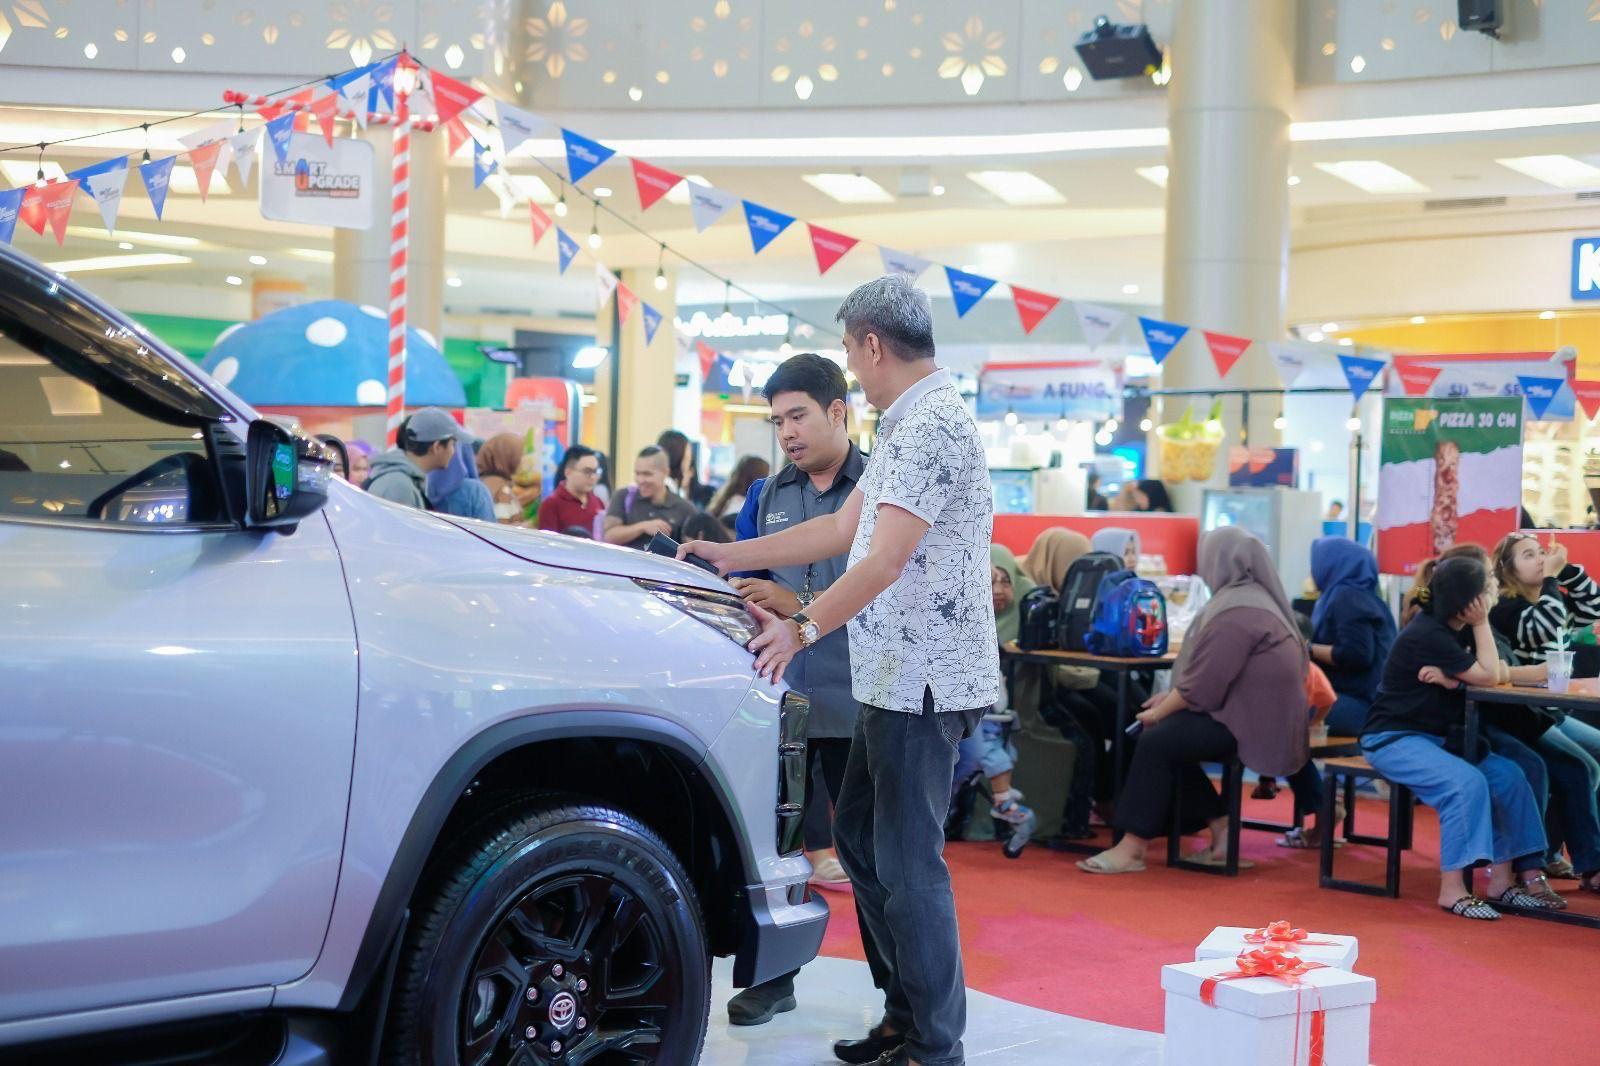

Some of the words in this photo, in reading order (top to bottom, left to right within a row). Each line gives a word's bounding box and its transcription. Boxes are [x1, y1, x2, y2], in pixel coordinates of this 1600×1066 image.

[275, 159, 326, 176] SMART
[295, 174, 360, 192] UPGRADE
[1440, 412, 1474, 428] PIZZA
[1479, 412, 1494, 428] 30
[1497, 412, 1516, 428] CM
